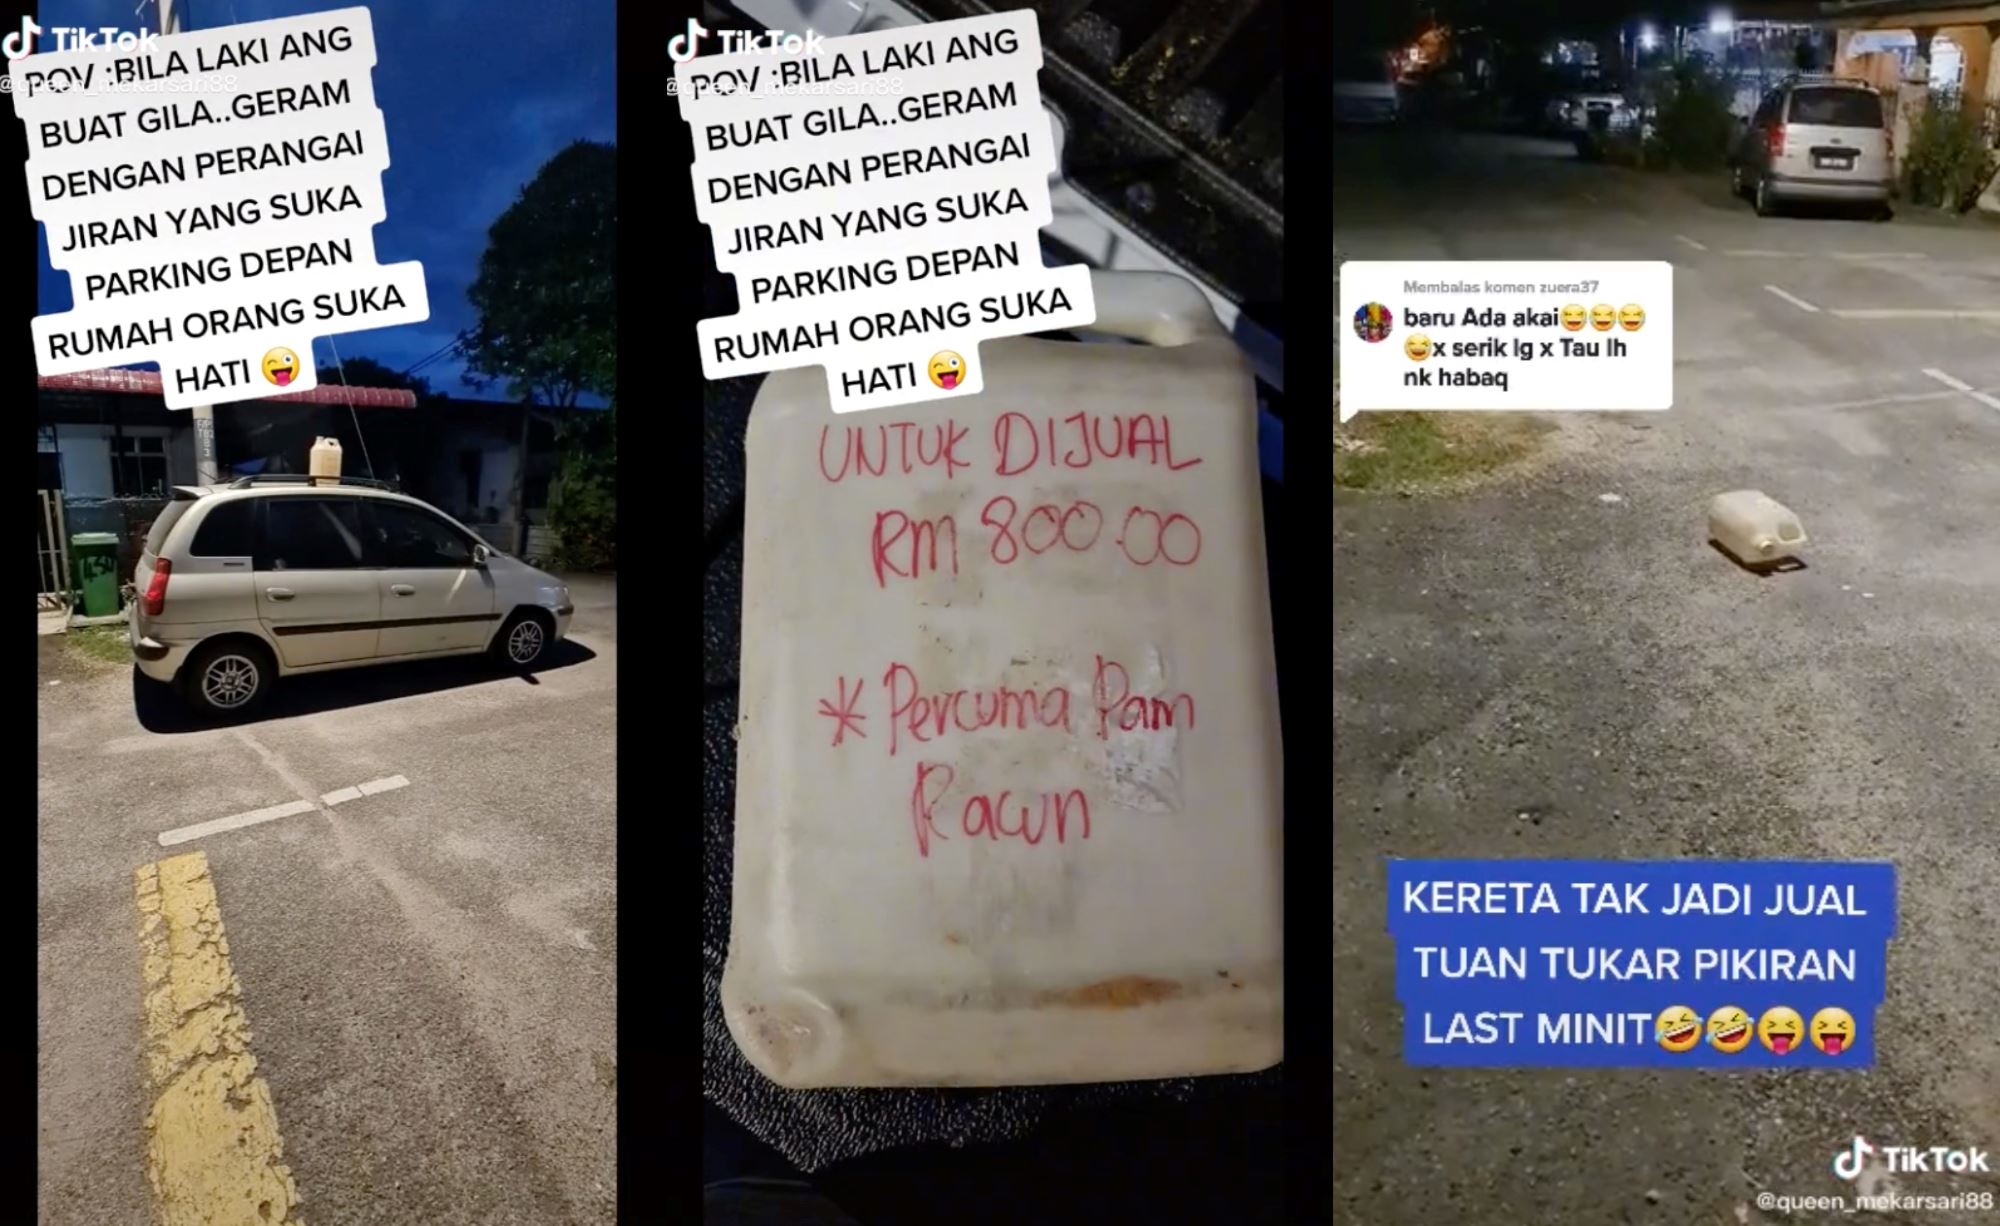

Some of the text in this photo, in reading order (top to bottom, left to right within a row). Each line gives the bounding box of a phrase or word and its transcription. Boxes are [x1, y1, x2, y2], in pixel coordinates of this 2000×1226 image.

[820, 411, 1203, 483] UNTUK DIJUAL
[883, 655, 1195, 757] Percuma Pam
[912, 761, 1091, 858] Racun
